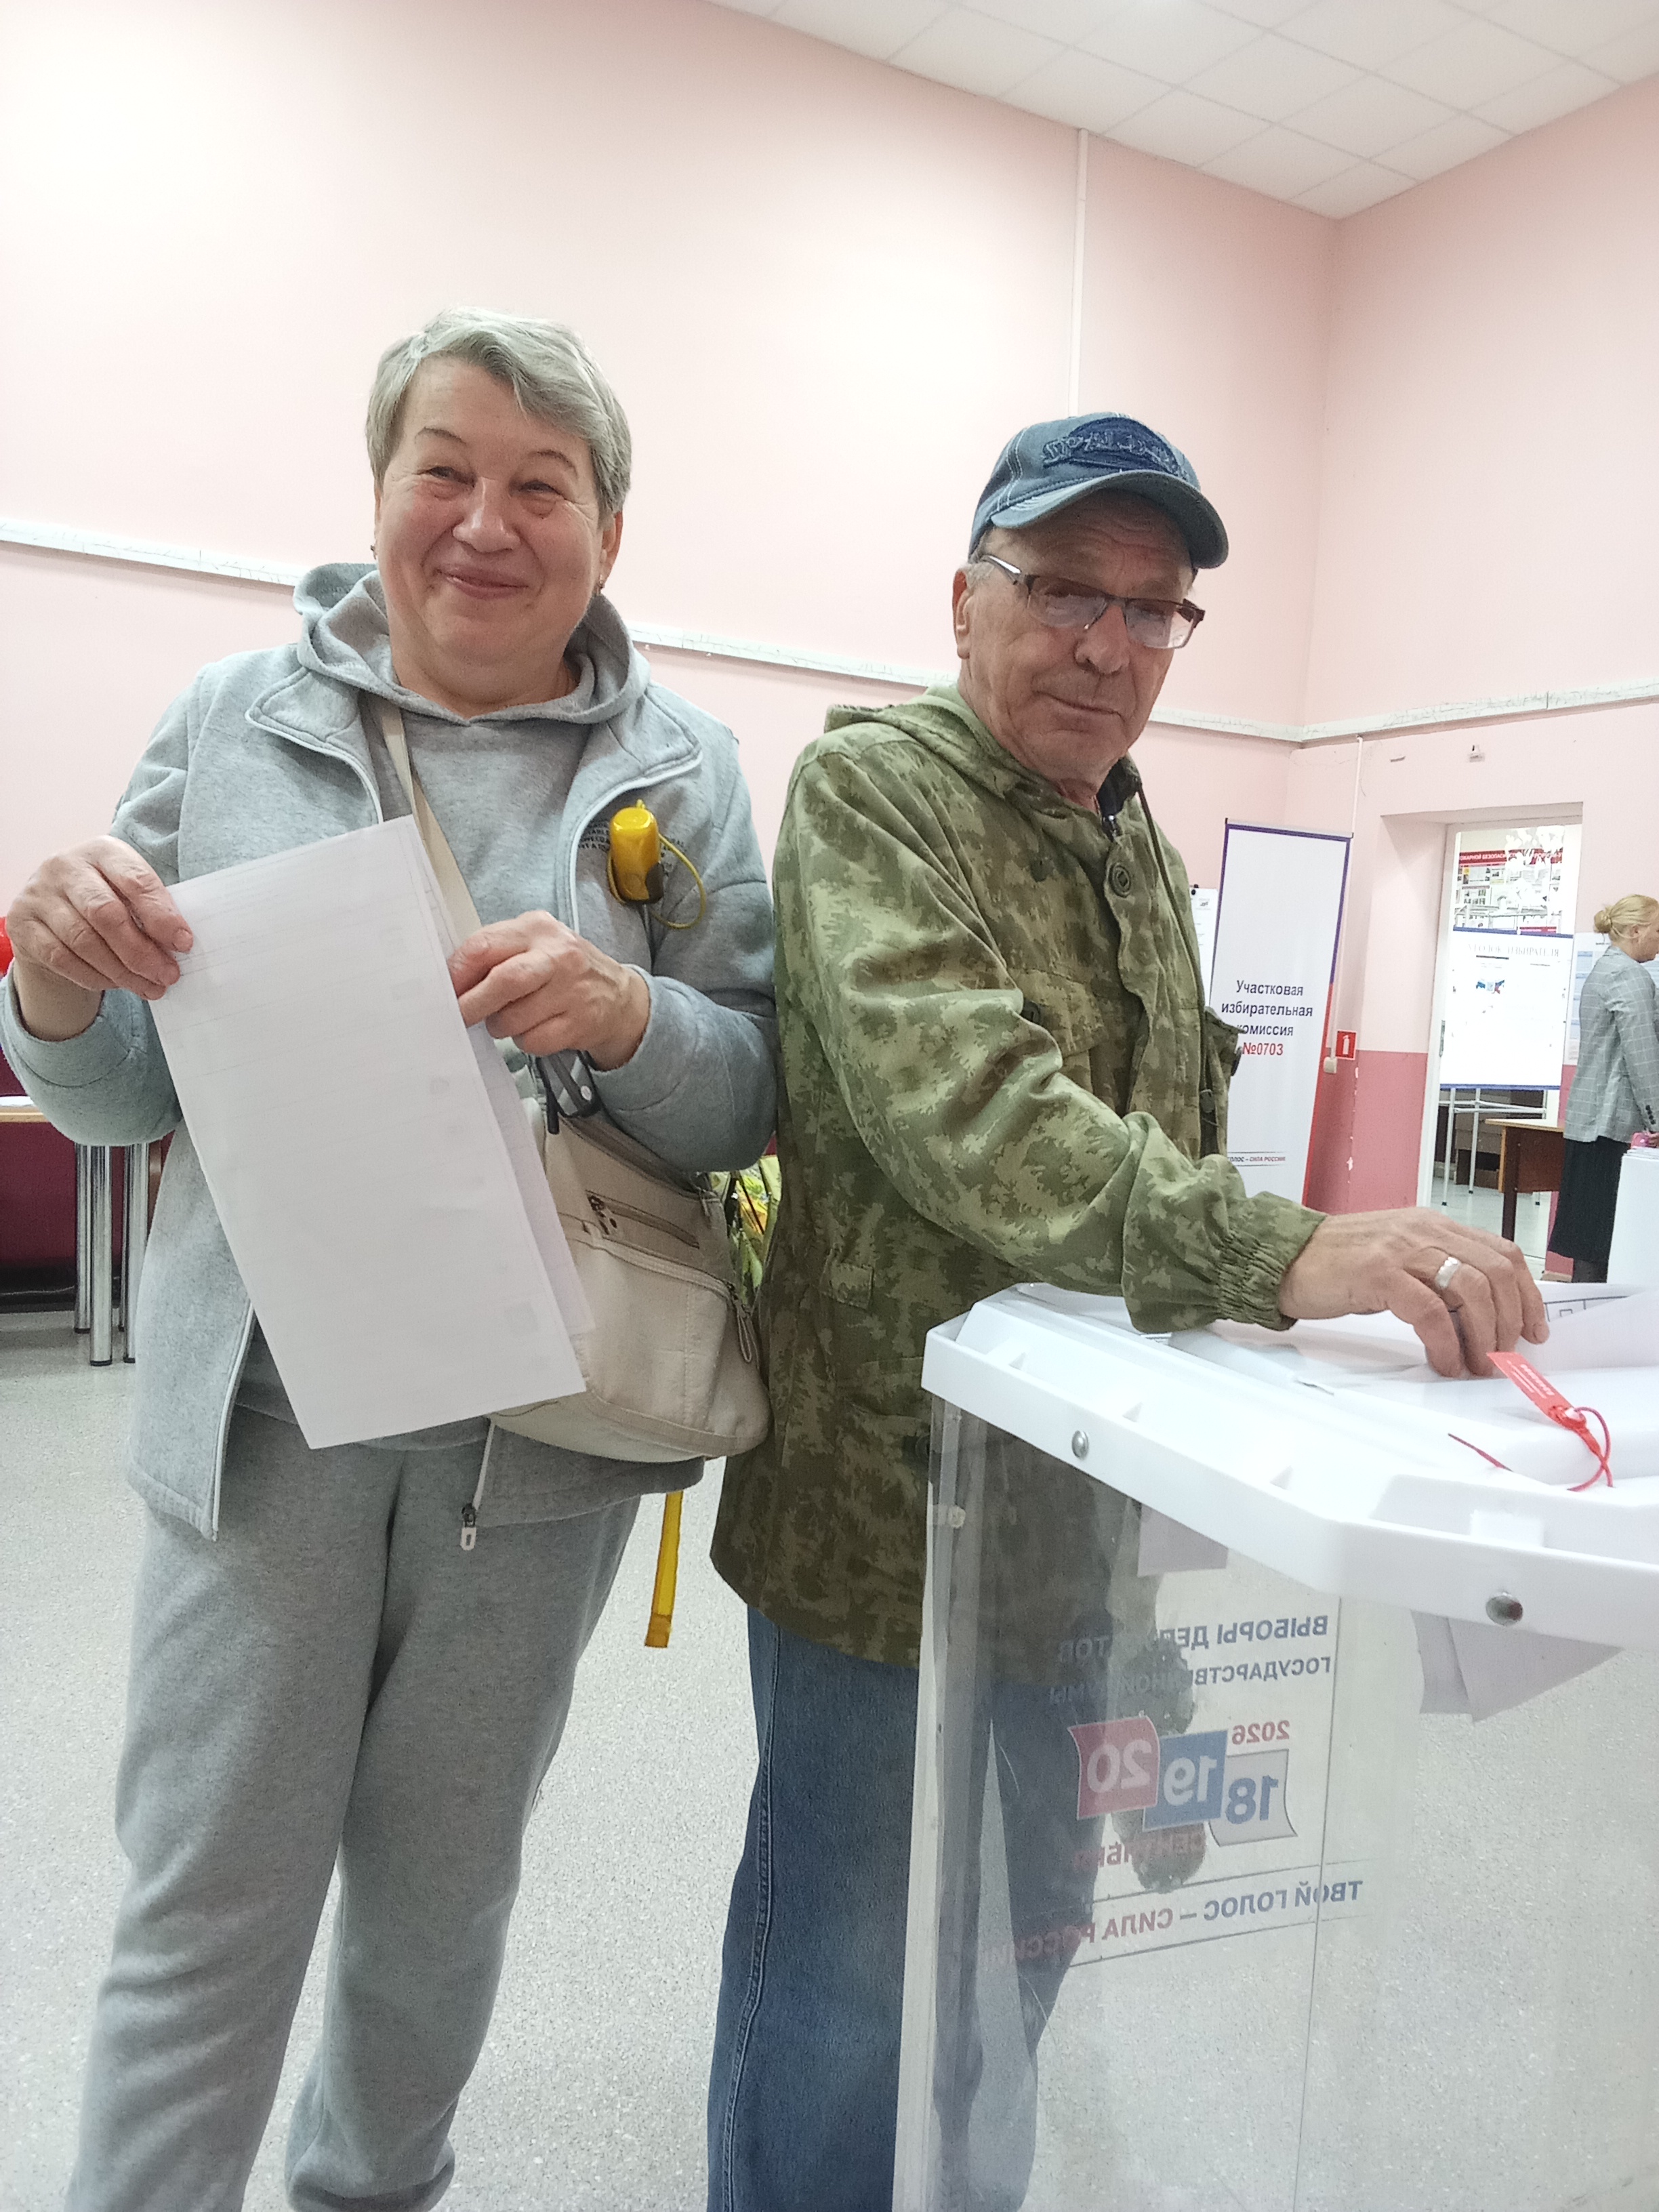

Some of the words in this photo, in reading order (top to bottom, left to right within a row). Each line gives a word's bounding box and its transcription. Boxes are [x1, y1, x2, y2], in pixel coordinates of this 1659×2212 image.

[1236, 980, 1304, 996] Участковая
[1221, 1001, 1313, 1017] избирательная
[1242, 1042, 1284, 1056] №0703
